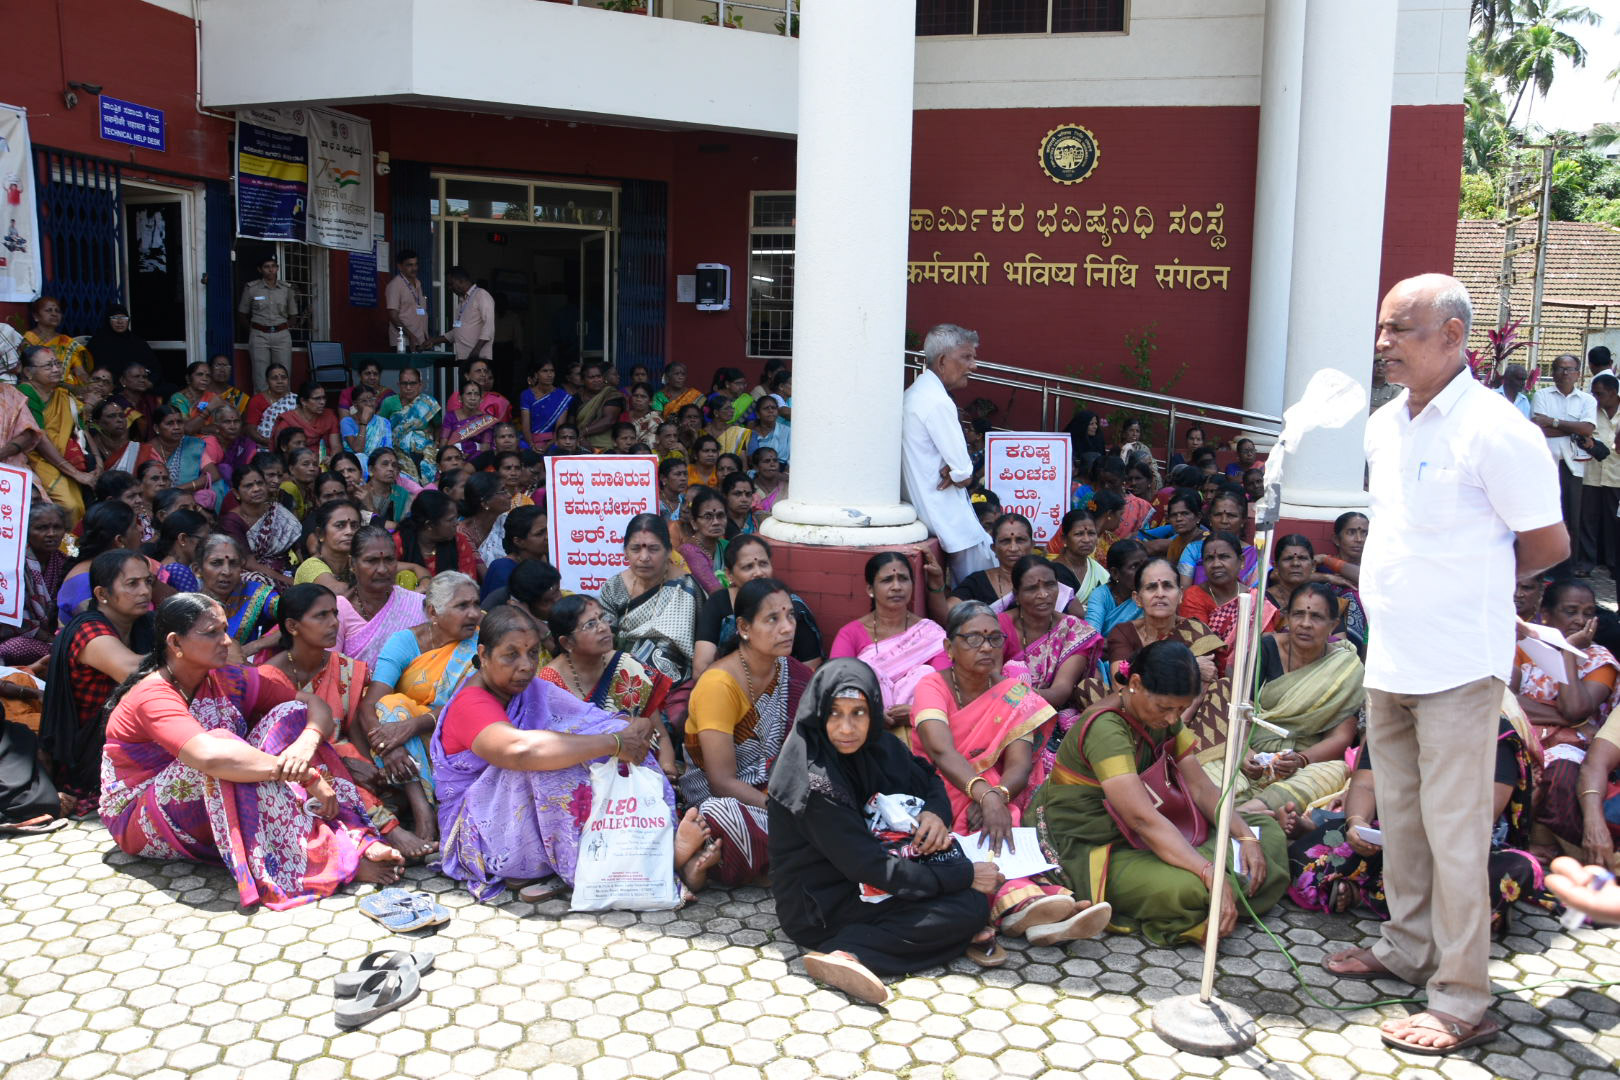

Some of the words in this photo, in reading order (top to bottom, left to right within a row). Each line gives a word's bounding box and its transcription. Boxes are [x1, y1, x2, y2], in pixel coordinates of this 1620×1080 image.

[104, 127, 133, 140] TECHNICAL
[134, 133, 147, 143] HELP
[147, 136, 161, 146] DESK
[911, 202, 1025, 232] ಕಾರ್ಮಿಕರ
[1168, 202, 1227, 250] ಸಂಸ್ಥೆ
[907, 251, 990, 285] कर्मचारी
[1003, 253, 1078, 287] भविष्य
[1083, 253, 1139, 288] निधि
[1154, 257, 1231, 291] संगठन
[559, 468, 585, 494] ರದ್ದು
[591, 467, 650, 488] ಮಾಡಿರುವ
[606, 796, 638, 815] LEO
[591, 815, 666, 832] COLLECTIONS
